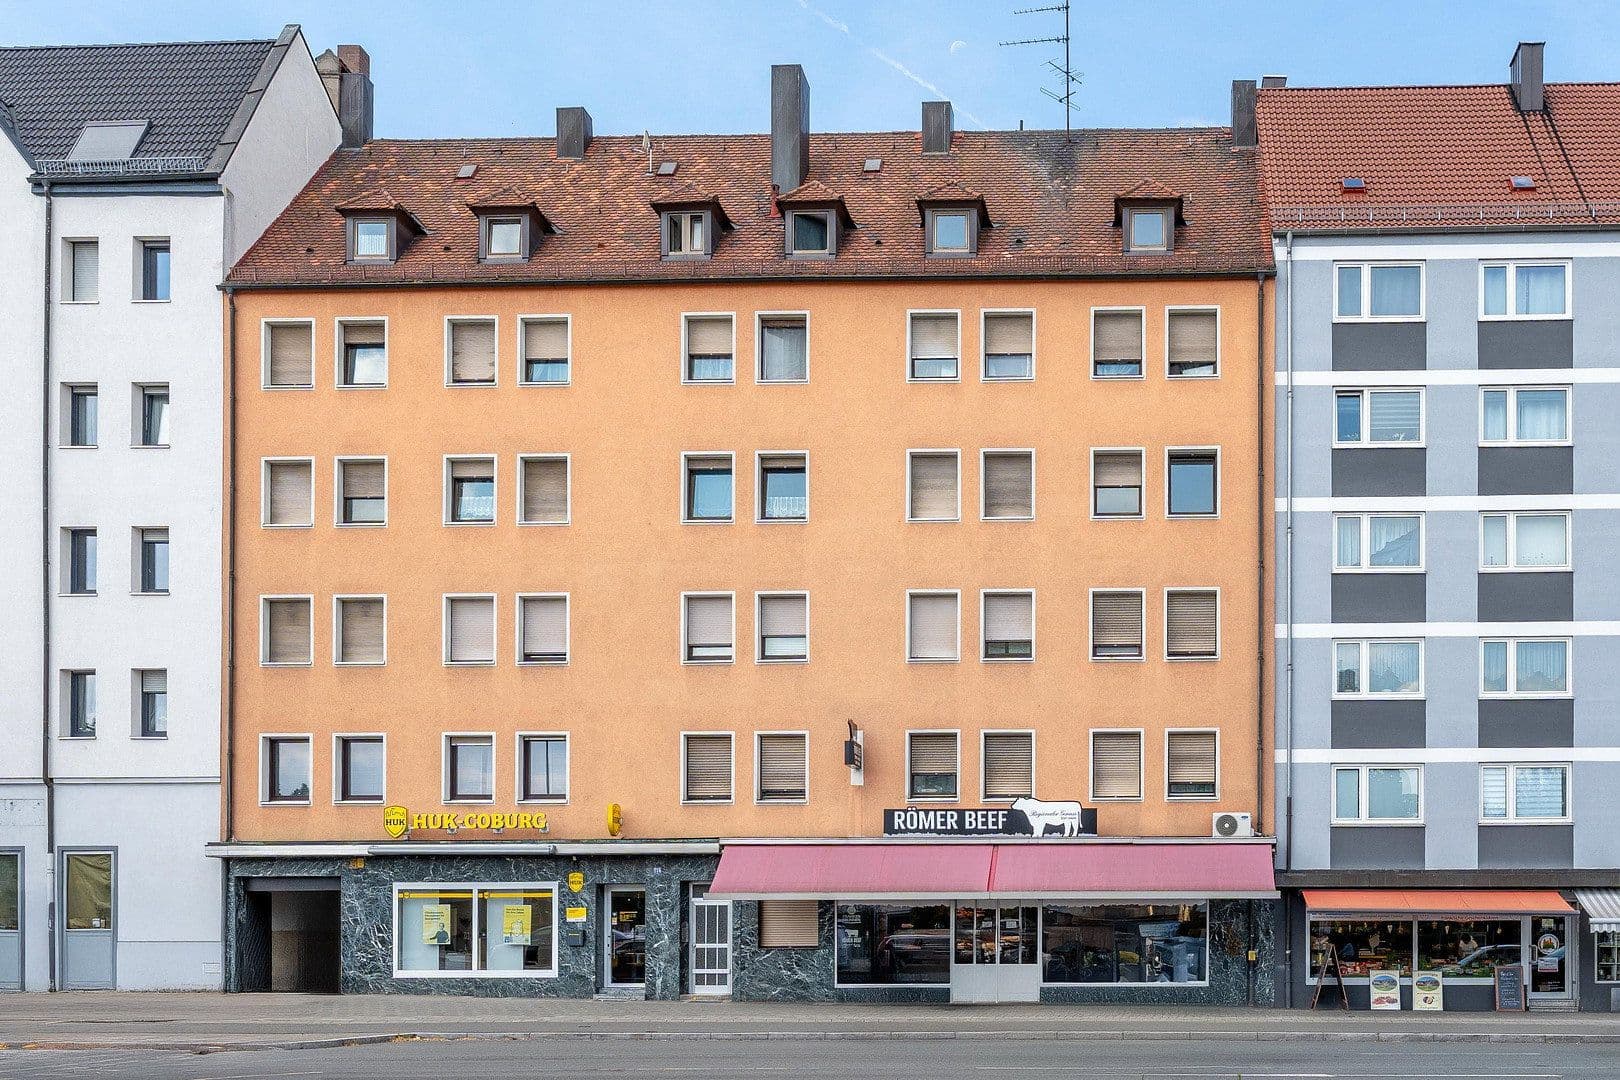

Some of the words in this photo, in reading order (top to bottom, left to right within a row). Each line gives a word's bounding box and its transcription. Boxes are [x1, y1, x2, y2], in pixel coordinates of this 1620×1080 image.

[385, 818, 406, 827] HUK
[412, 812, 548, 830] HUK-COBURG
[893, 806, 959, 830] RÖMER
[964, 810, 1009, 830] BEEF
